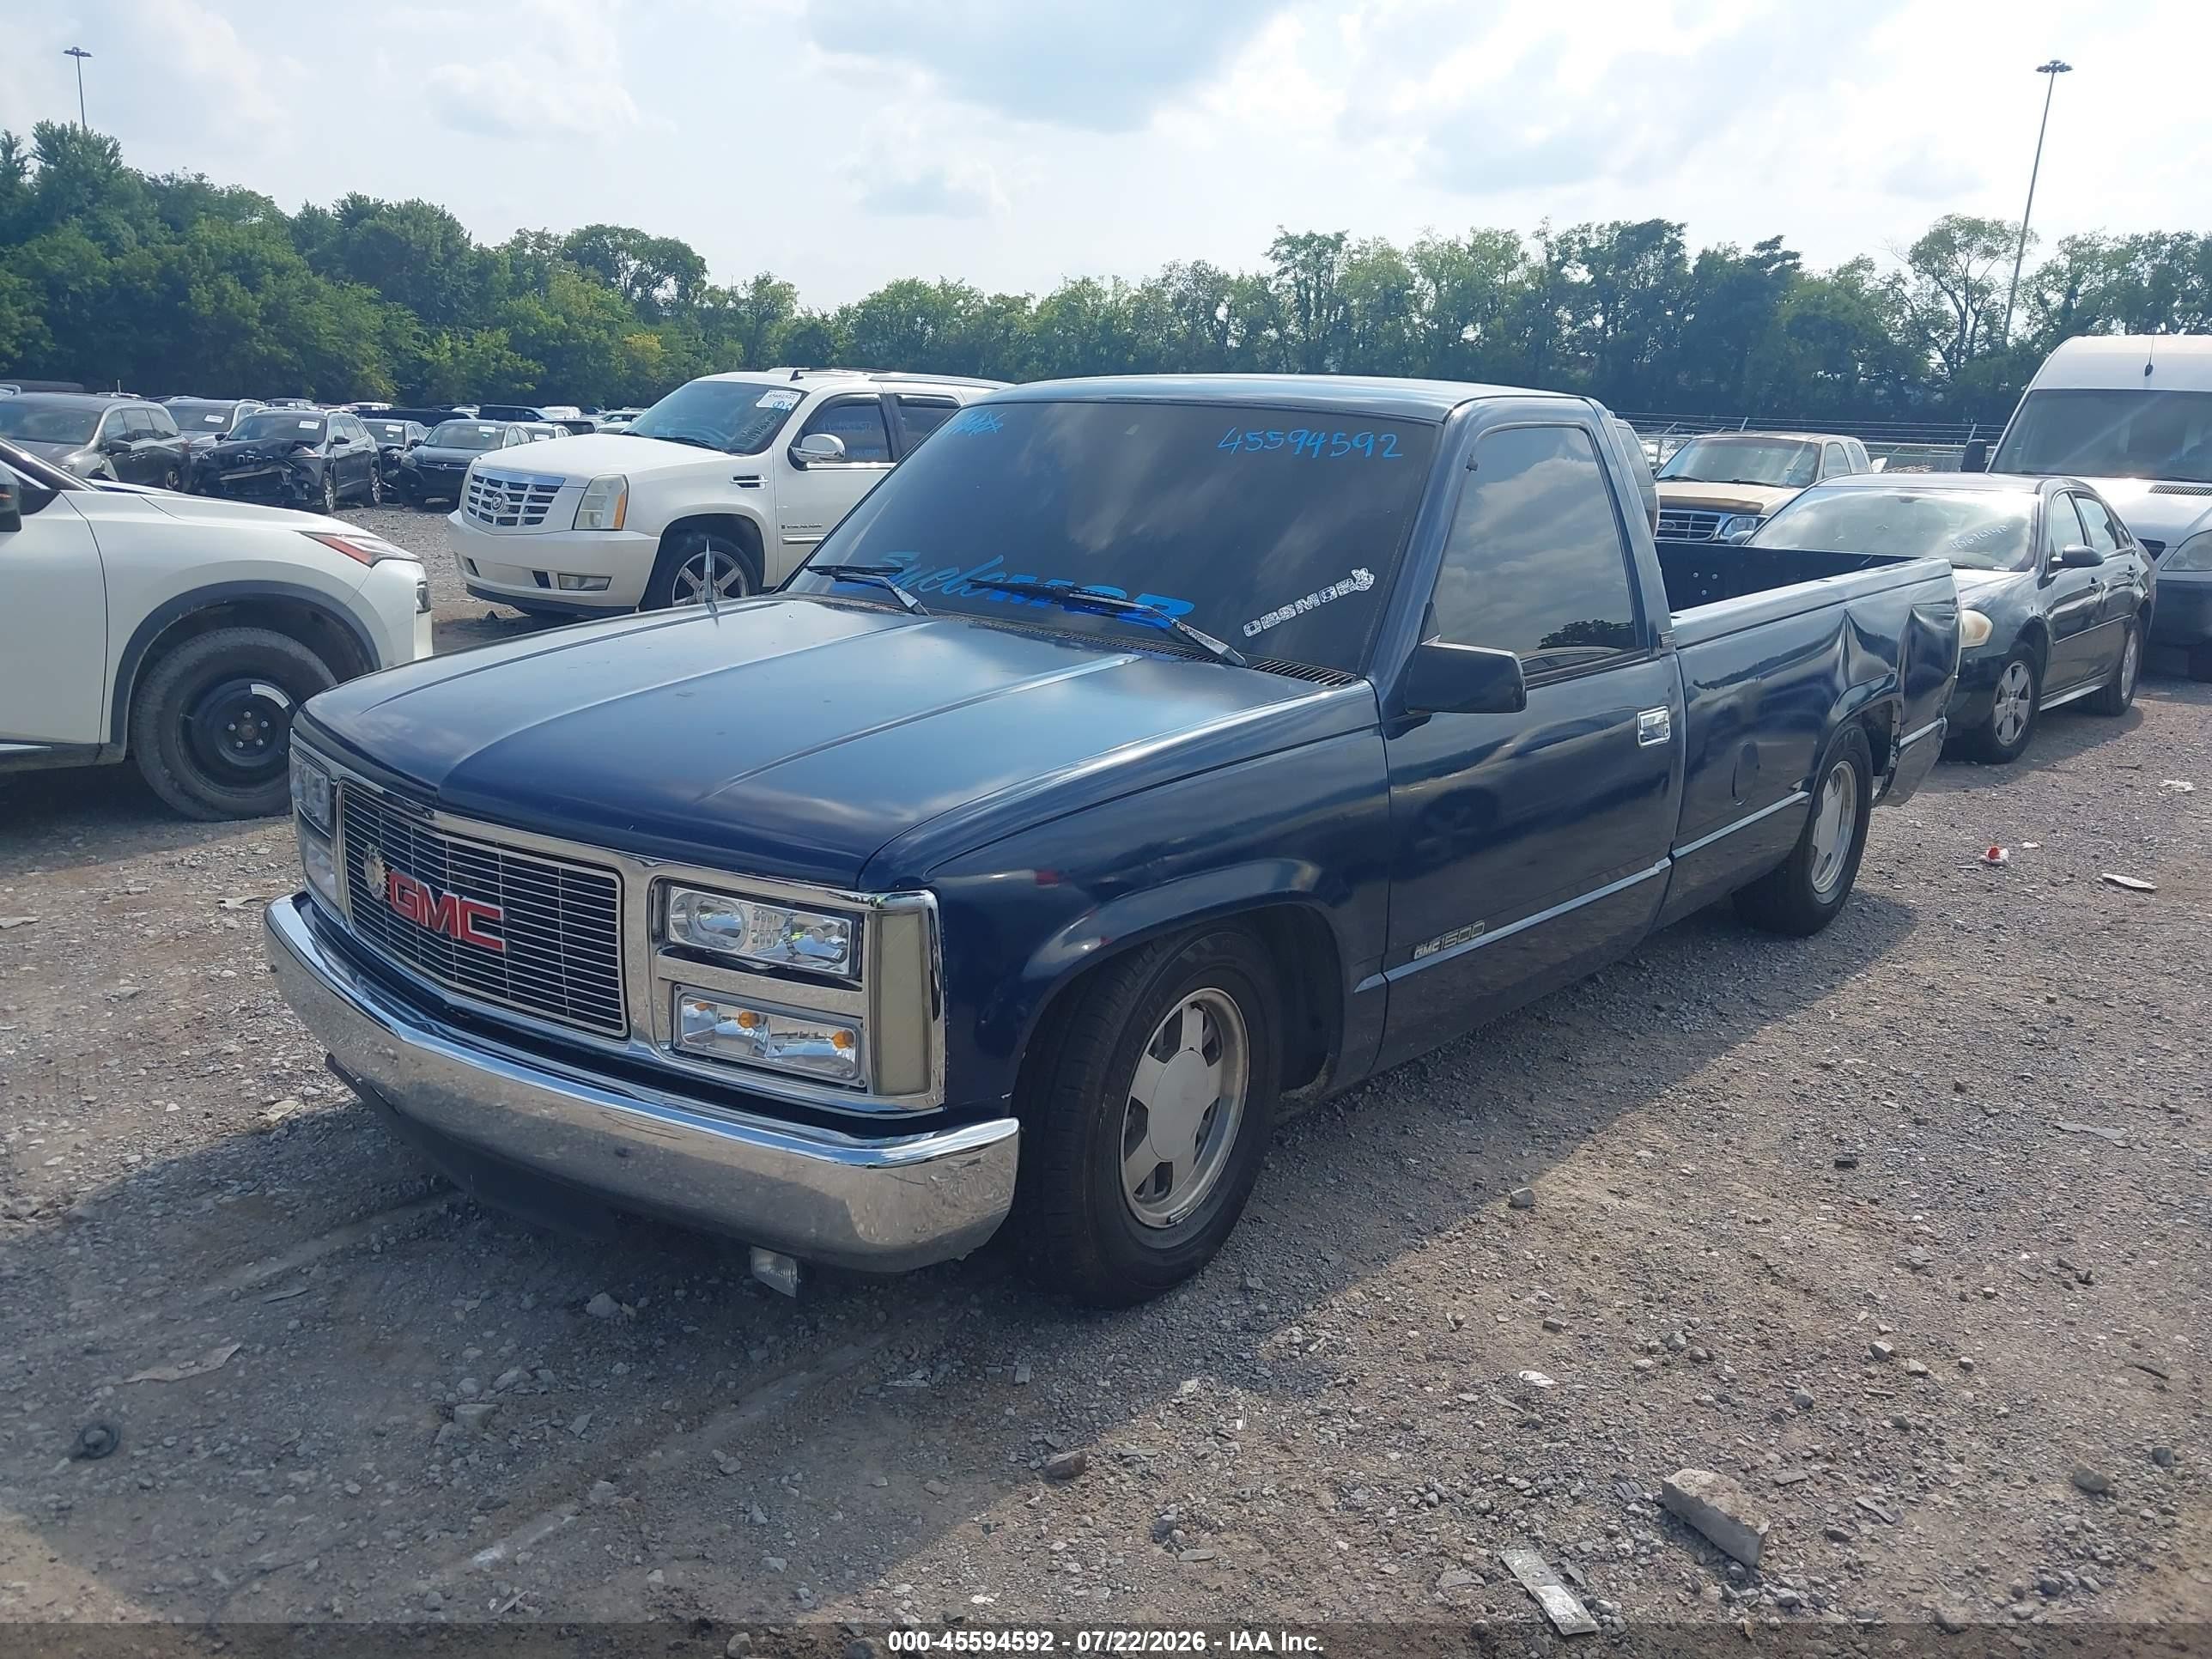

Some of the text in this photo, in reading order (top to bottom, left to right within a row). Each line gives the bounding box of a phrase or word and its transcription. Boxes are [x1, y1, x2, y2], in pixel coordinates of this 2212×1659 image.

[1217, 426, 1404, 459] 45594592
[389, 868, 507, 954] GMC
[1413, 920, 1486, 960] GMC 1500
